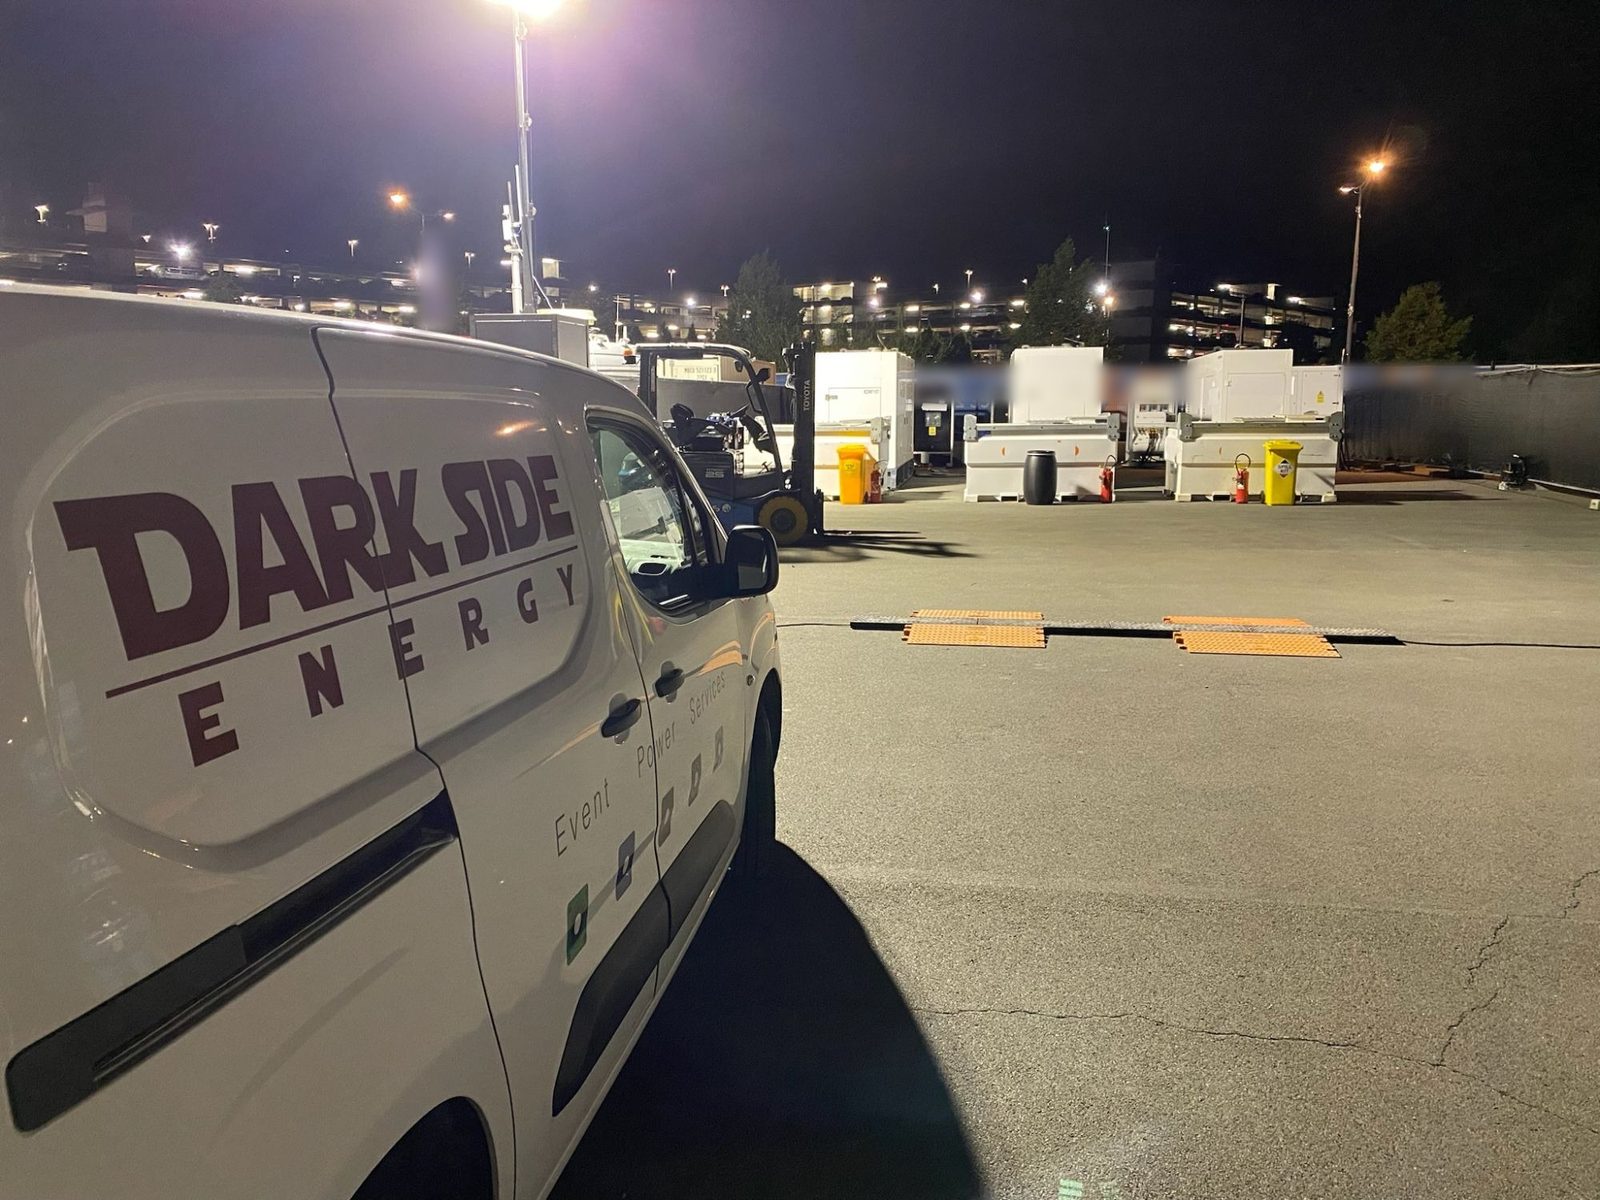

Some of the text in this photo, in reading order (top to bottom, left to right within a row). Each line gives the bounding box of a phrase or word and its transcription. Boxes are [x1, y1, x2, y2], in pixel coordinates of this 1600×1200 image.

[803, 379, 811, 411] TOYOTA
[53, 455, 574, 661] DARK SIDE
[178, 564, 578, 767] ENERGY
[554, 671, 726, 858] Event Power Services
